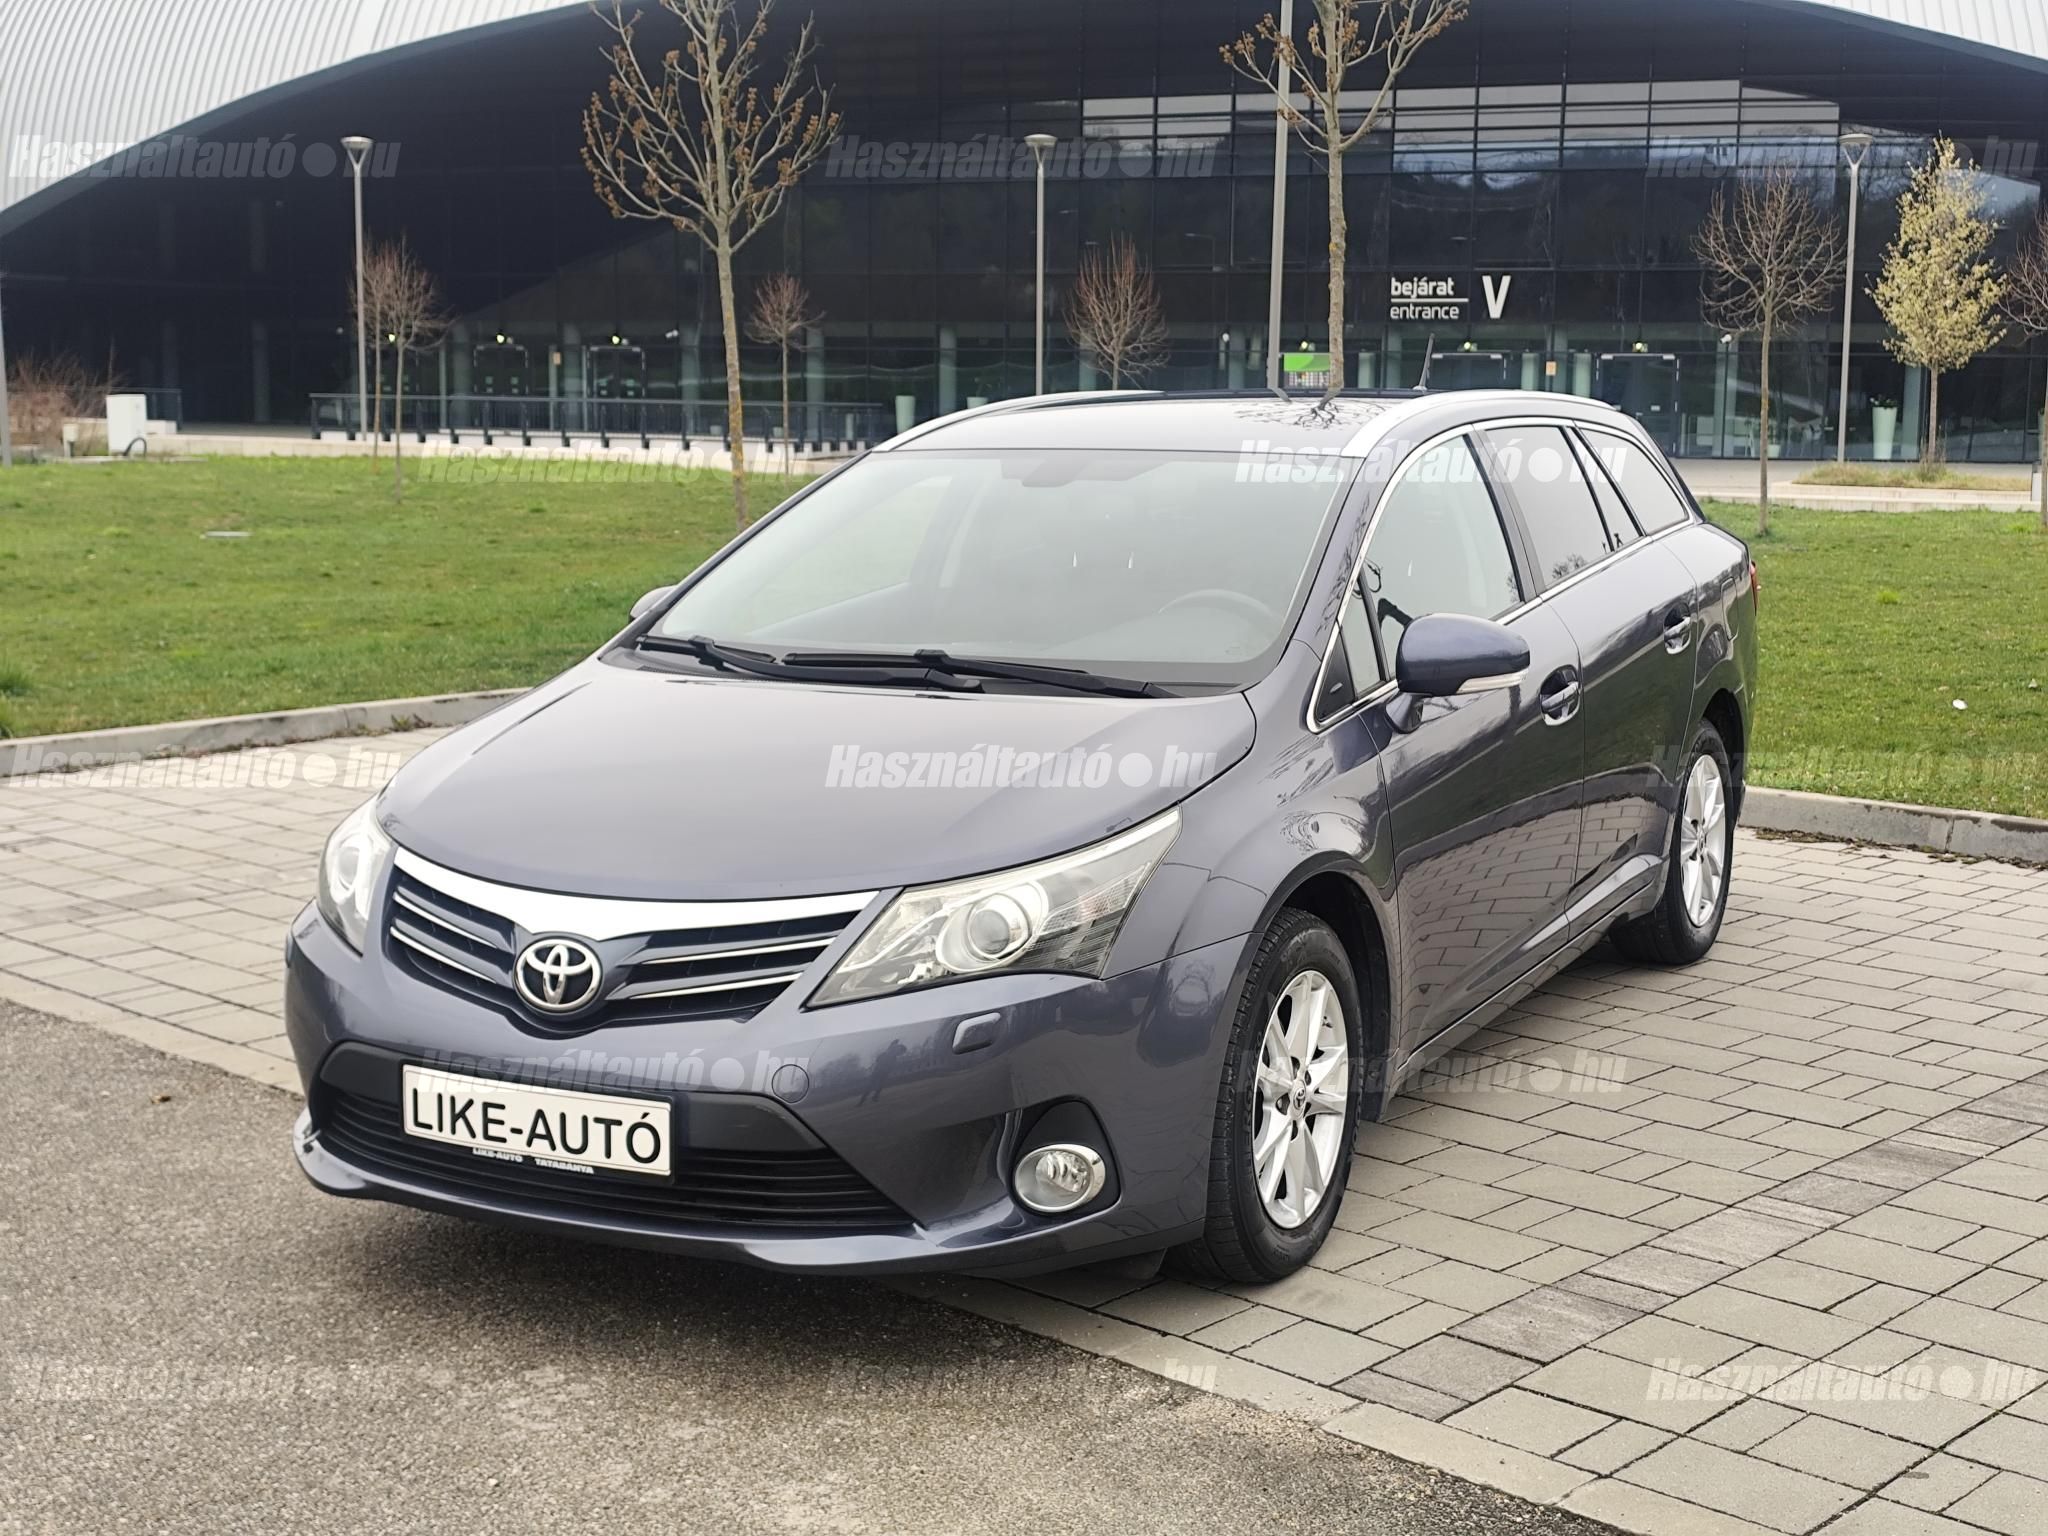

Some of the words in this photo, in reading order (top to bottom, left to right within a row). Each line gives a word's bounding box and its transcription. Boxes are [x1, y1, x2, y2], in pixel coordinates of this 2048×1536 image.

[1390, 276, 1455, 299] bejárat
[1482, 275, 1511, 319] V
[1390, 303, 1460, 319] entrance
[412, 1087, 661, 1164] LIKE-AUTÓ
